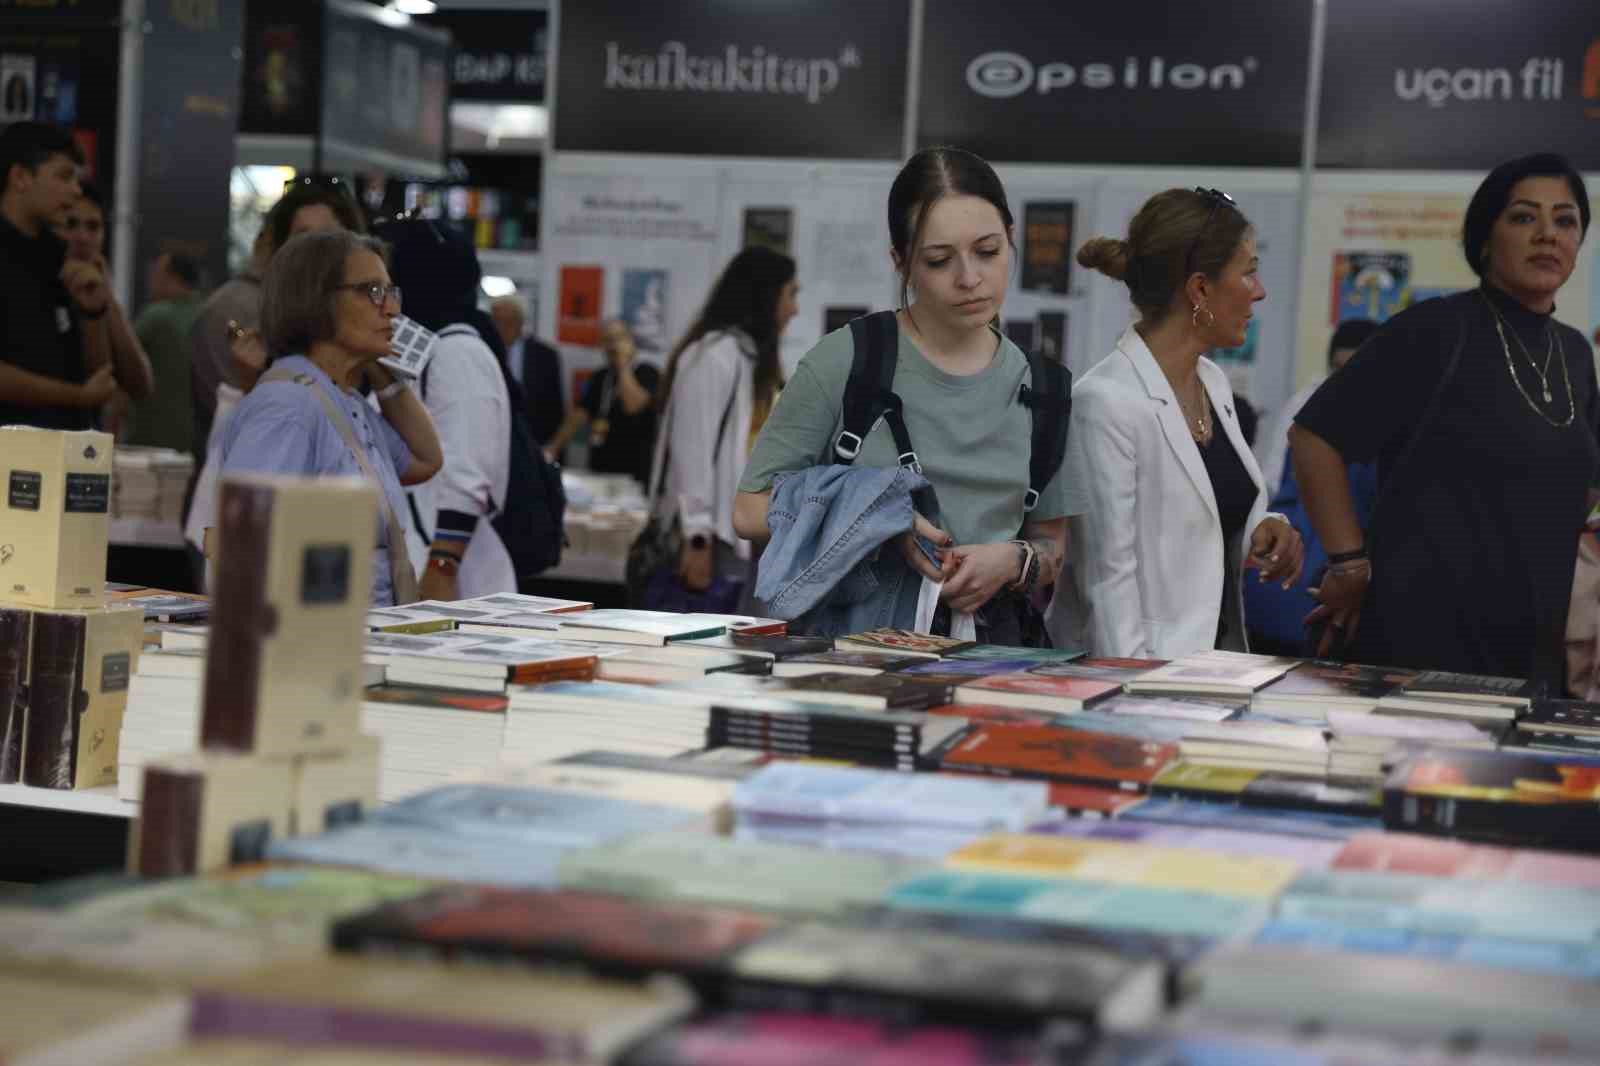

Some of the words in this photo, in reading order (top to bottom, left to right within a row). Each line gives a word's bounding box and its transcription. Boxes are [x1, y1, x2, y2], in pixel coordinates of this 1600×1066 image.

[965, 51, 1245, 98] epsilon
[1394, 66, 1513, 108] uçan
[1520, 57, 1564, 101] fil
